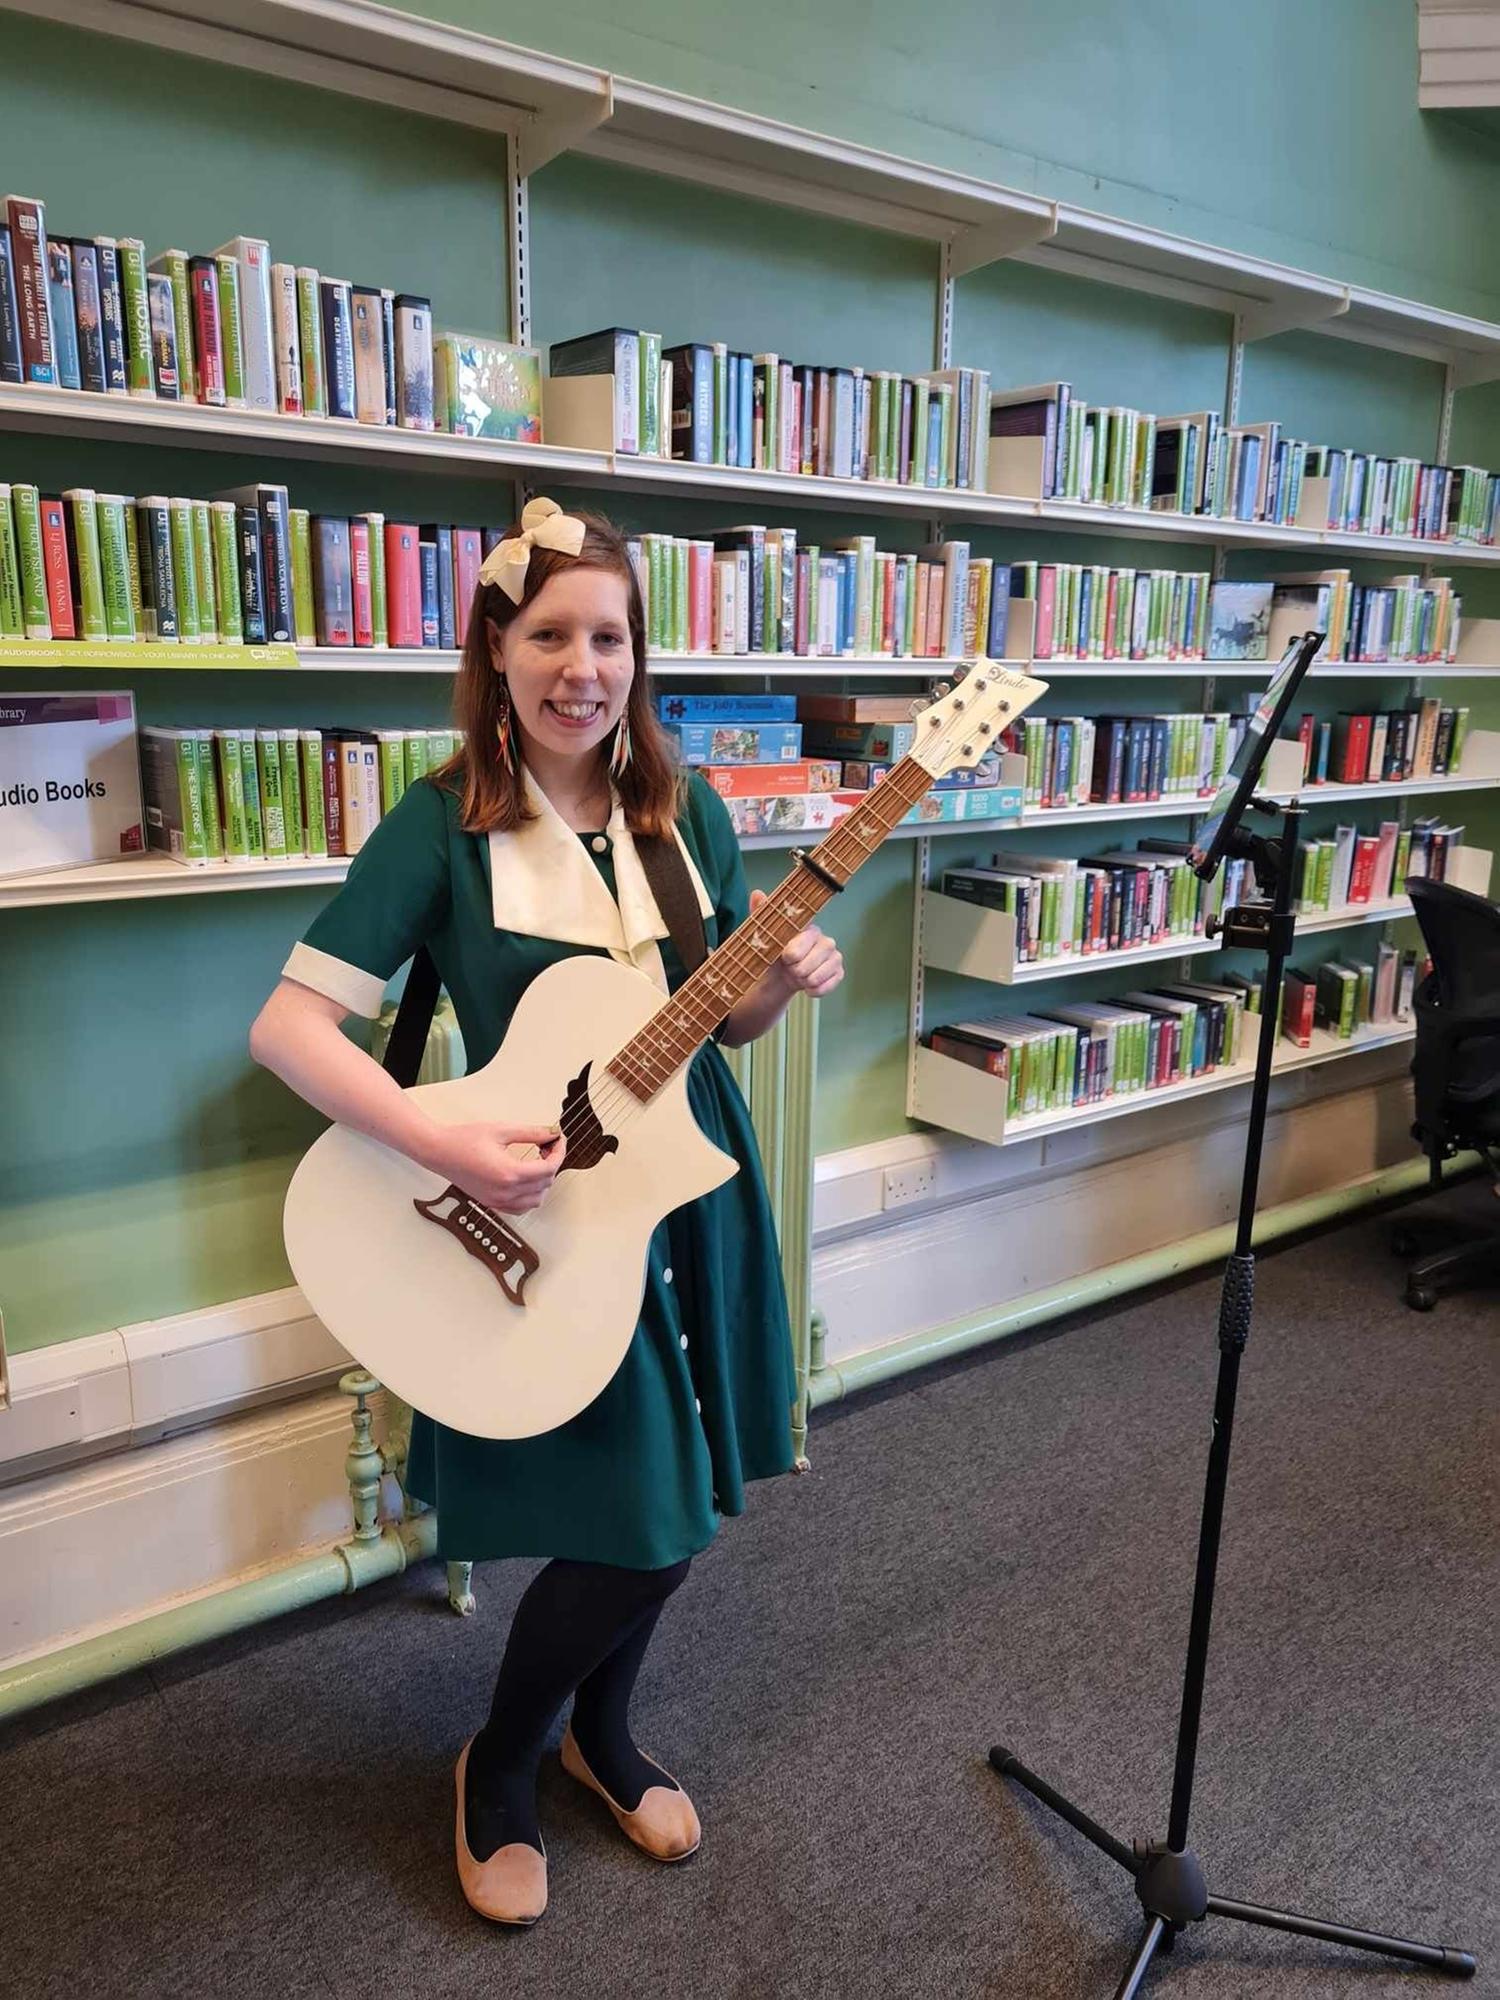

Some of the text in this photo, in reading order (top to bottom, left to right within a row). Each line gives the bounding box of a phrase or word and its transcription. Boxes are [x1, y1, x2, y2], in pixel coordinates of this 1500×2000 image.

[32, 245, 40, 264] TERRY
[35, 266, 45, 300] PRATCHETT
[22, 264, 35, 339] THE LONG EARTH
[103, 288, 113, 321] UPSTAIRS
[202, 293, 213, 310] IAN
[39, 311, 48, 337] STEPHEN
[135, 288, 152, 360] MOSAIC
[204, 315, 216, 354] RANKIN
[333, 317, 341, 344] DEATH
[41, 339, 51, 362] BAXTER
[336, 347, 342, 356] IN
[36, 367, 50, 376] SCI
[4, 544, 12, 572] Museum
[23, 551, 32, 578] ROSS
[29, 524, 42, 597] HOLY ISLAND
[52, 544, 62, 569] ROSS
[112, 535, 127, 609] CHOSEN ONES
[356, 550, 368, 585] FALLOW
[128, 542, 140, 614] CHINA ROOM
[278, 563, 288, 614] SCARROW
[55, 578, 66, 612] MANIA
[46, 779, 106, 801] Books
[392, 766, 400, 805] TESTAMEN
